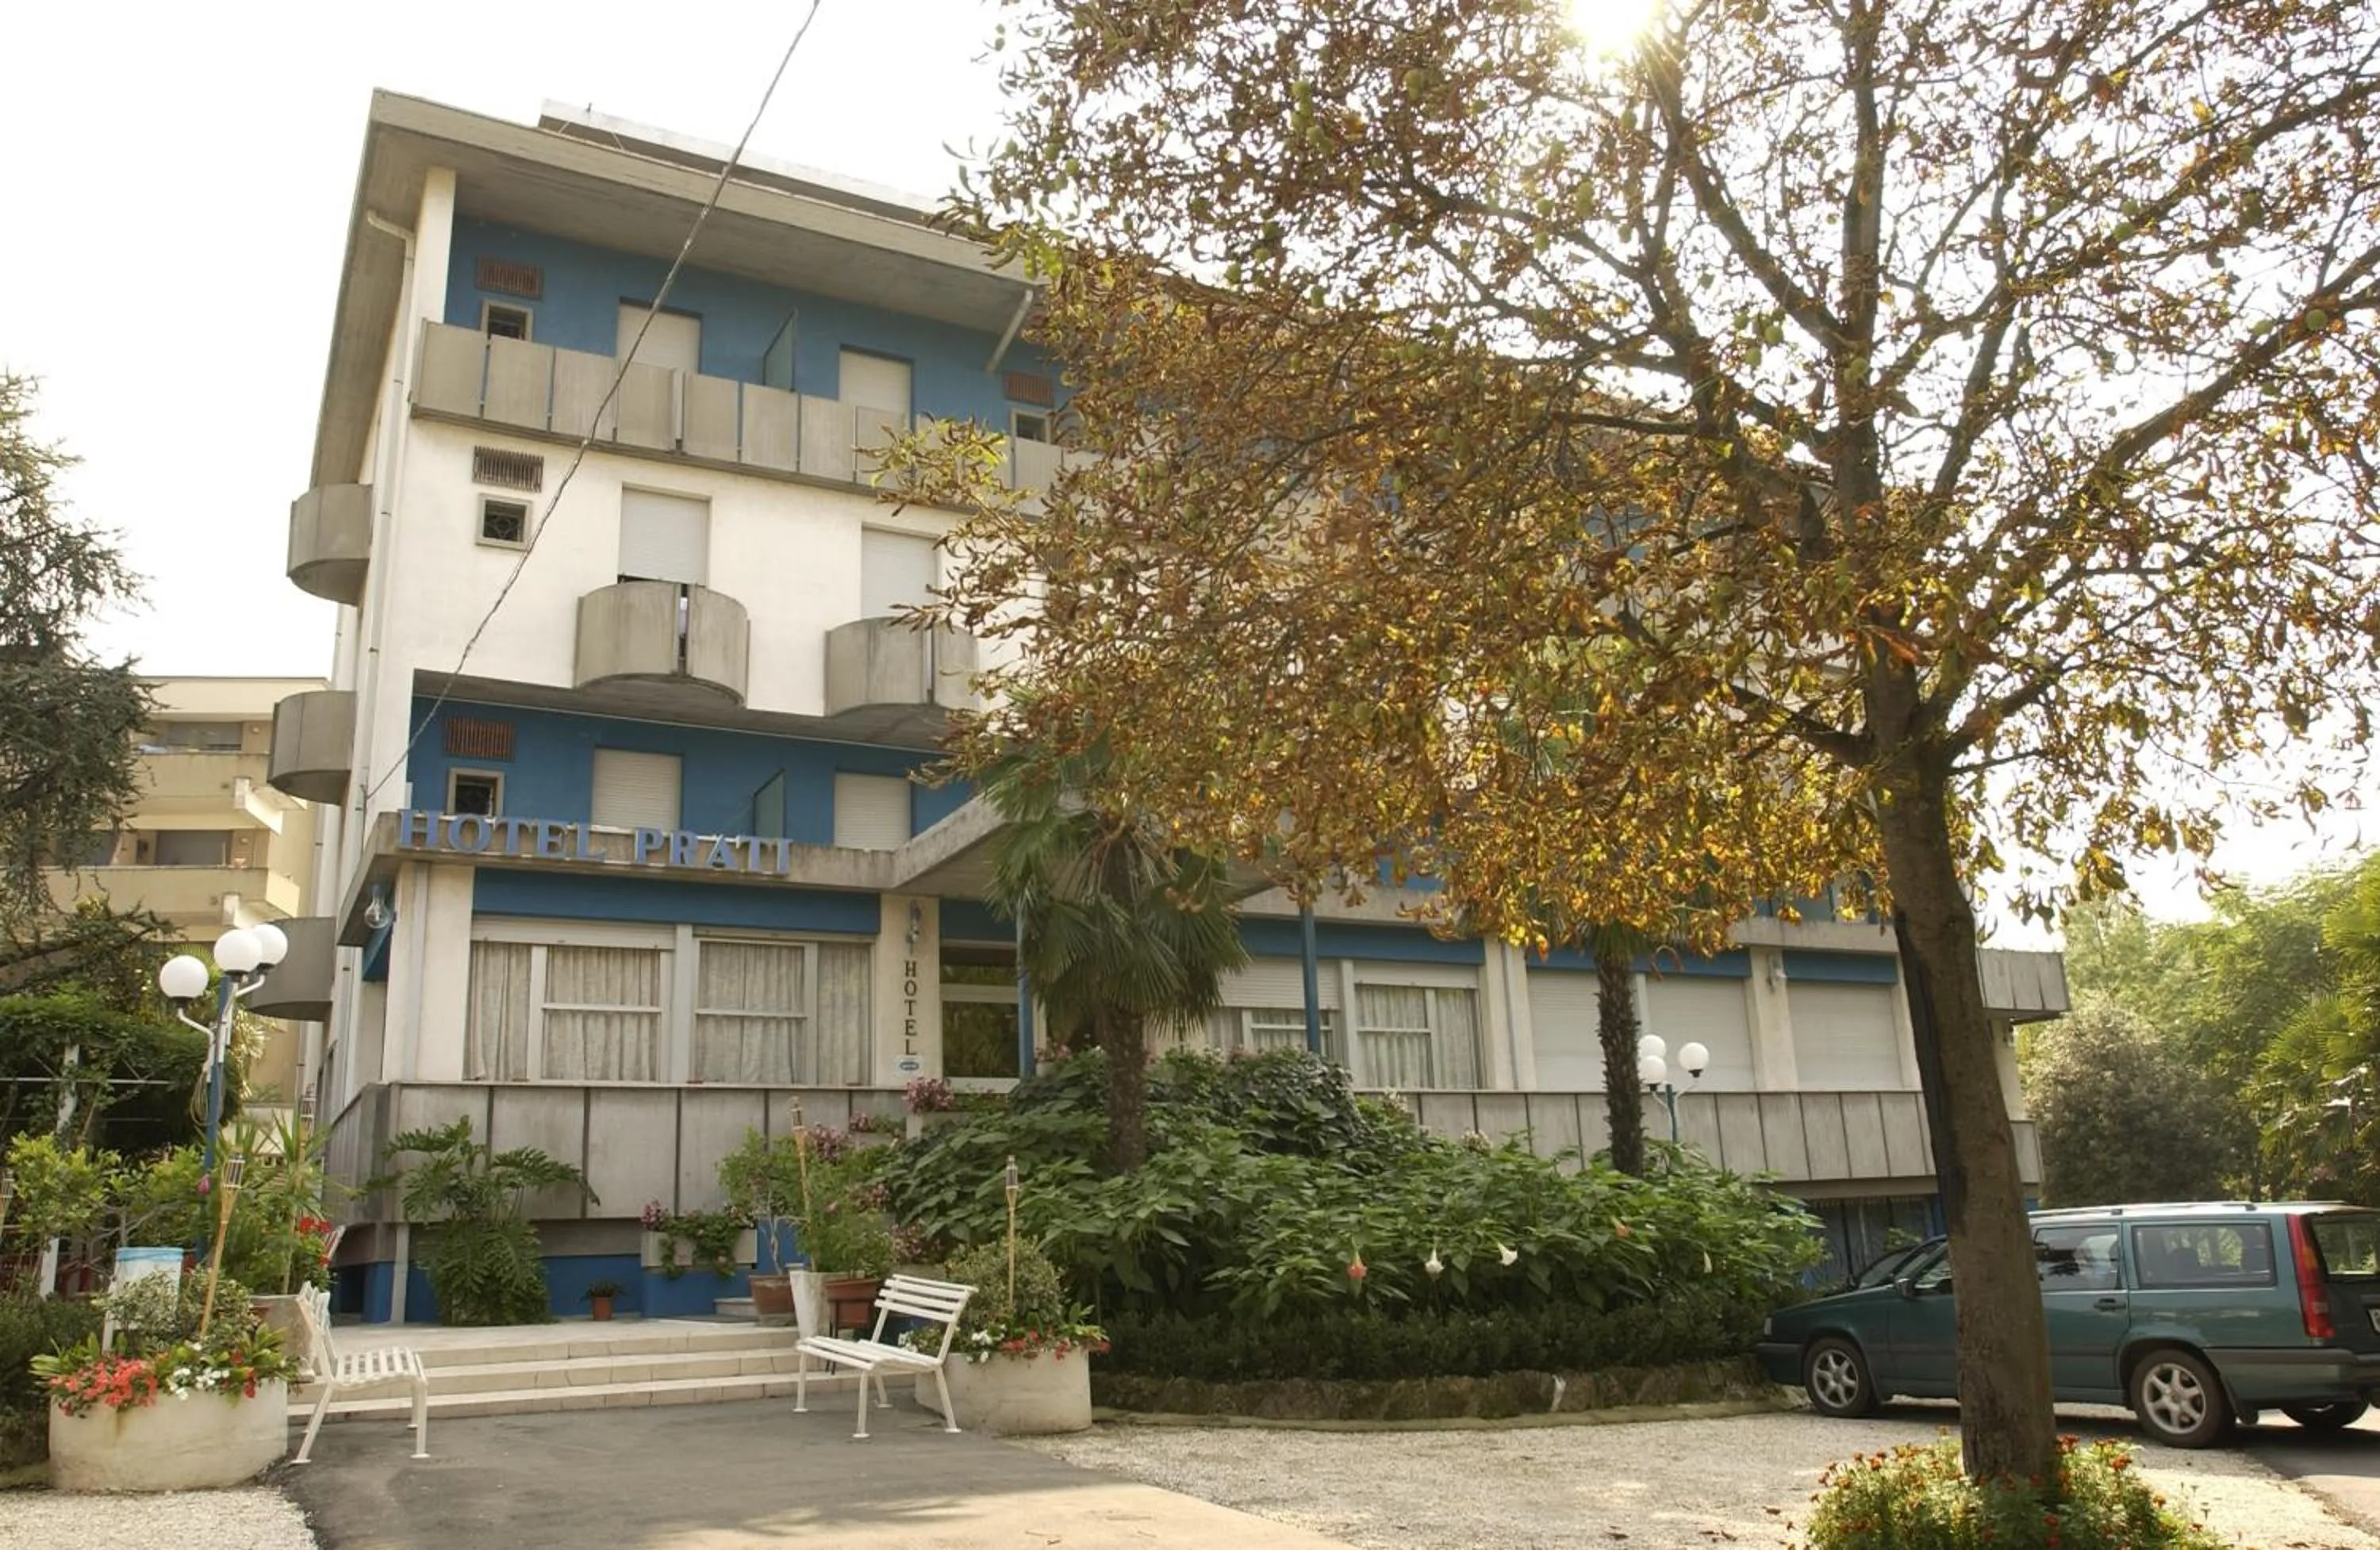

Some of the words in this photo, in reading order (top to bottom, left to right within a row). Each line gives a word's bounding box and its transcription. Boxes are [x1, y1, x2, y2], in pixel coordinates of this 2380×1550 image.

[398, 809, 606, 861] HOTEL
[634, 826, 793, 875] PRATI
[904, 960, 918, 1056] HOTEL
